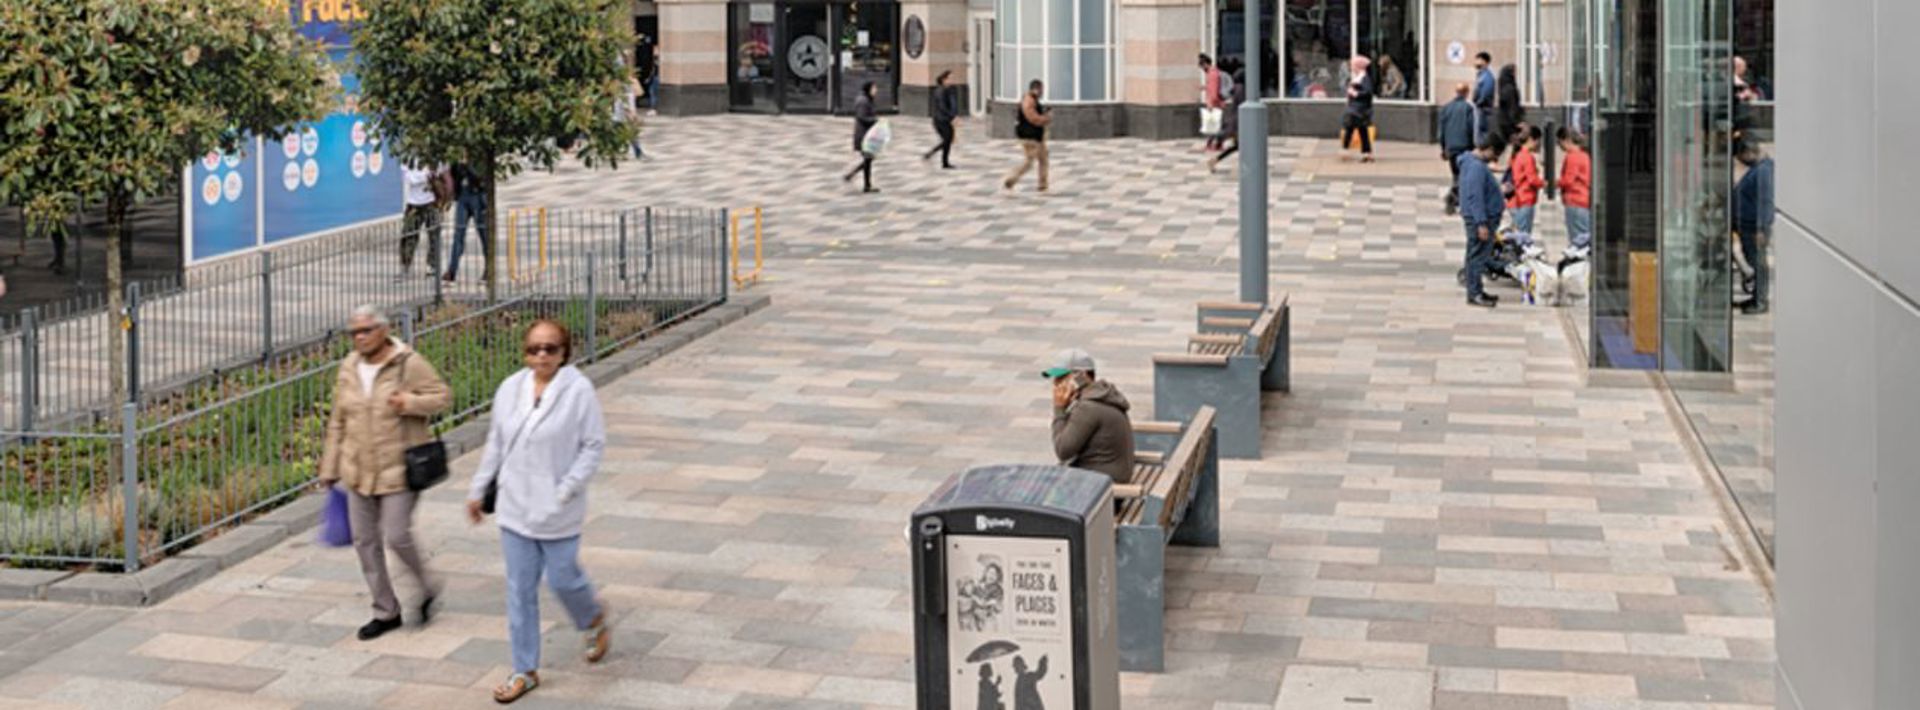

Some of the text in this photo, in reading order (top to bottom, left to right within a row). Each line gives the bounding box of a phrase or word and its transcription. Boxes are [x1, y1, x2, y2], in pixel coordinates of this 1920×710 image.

[1012, 572, 1058, 592] FACES &
[1015, 595, 1056, 615] PLACES
